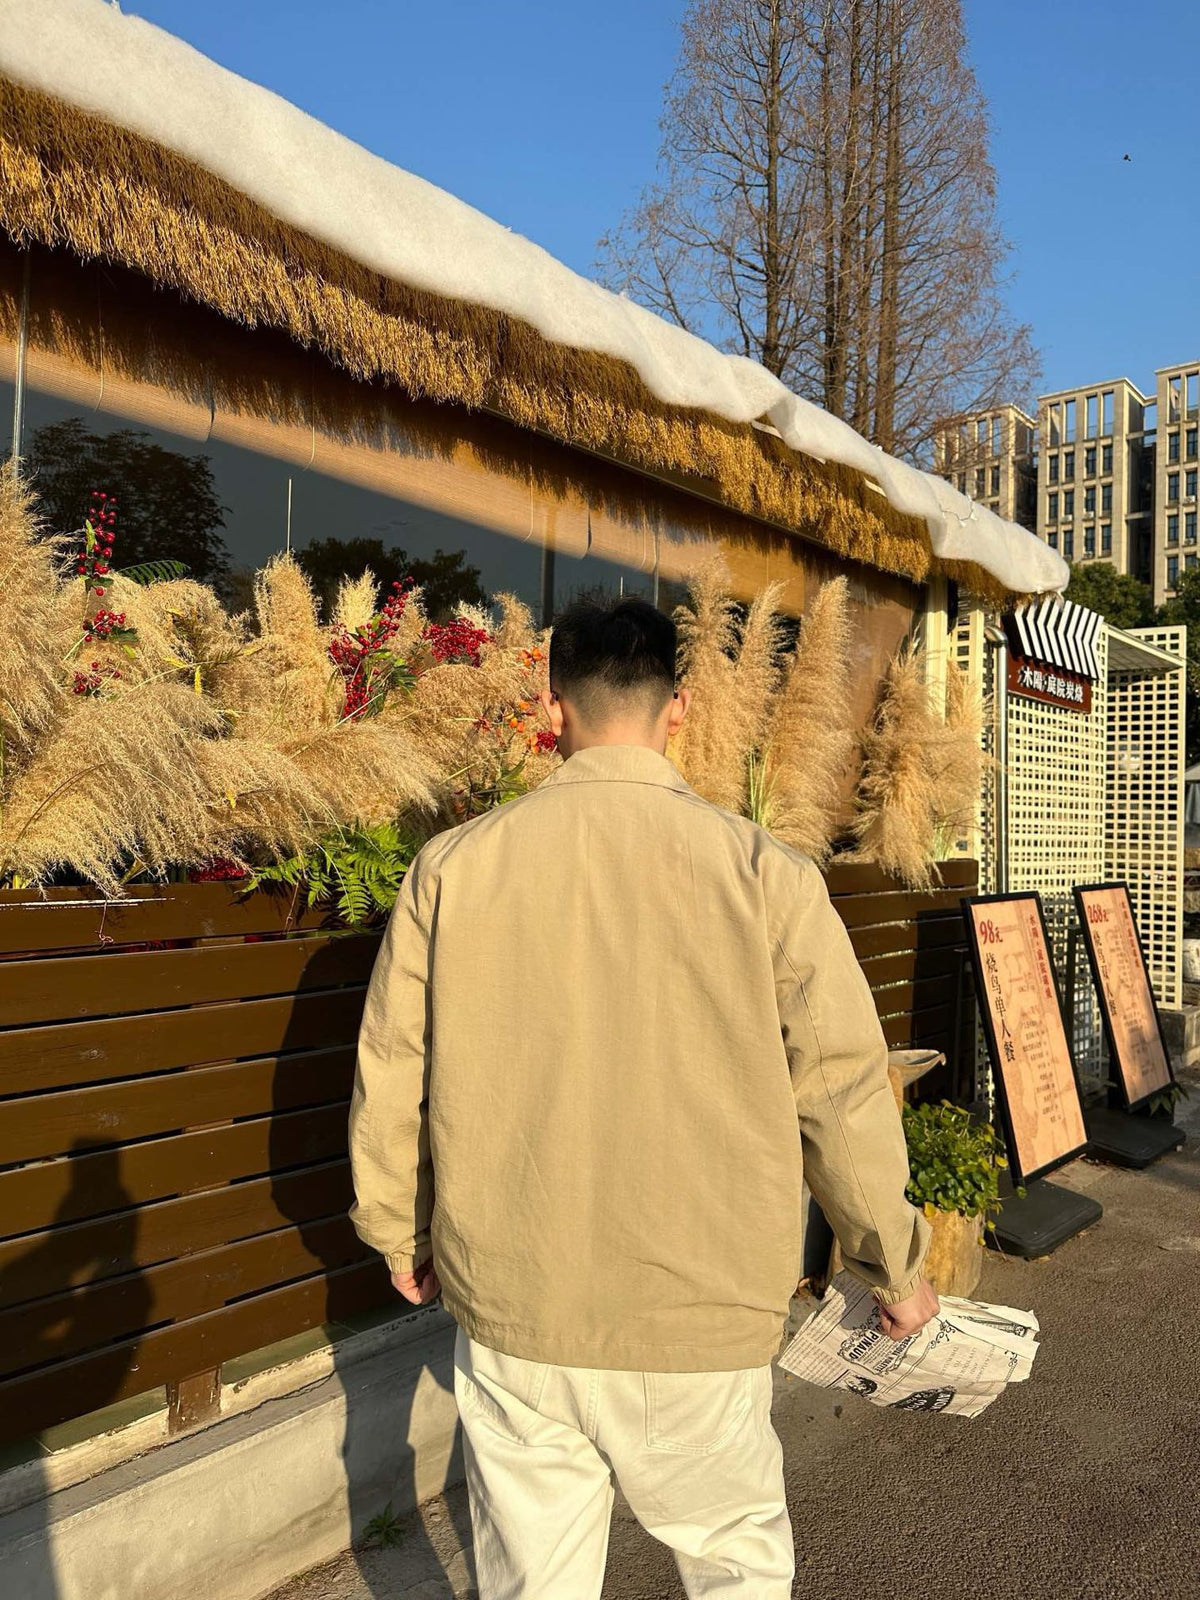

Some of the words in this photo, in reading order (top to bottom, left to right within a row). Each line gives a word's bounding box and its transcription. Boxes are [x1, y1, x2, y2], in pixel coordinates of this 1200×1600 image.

[985, 952, 1016, 1063] 烧鸟单人餐
[849, 1330, 879, 1360] PINAUD
